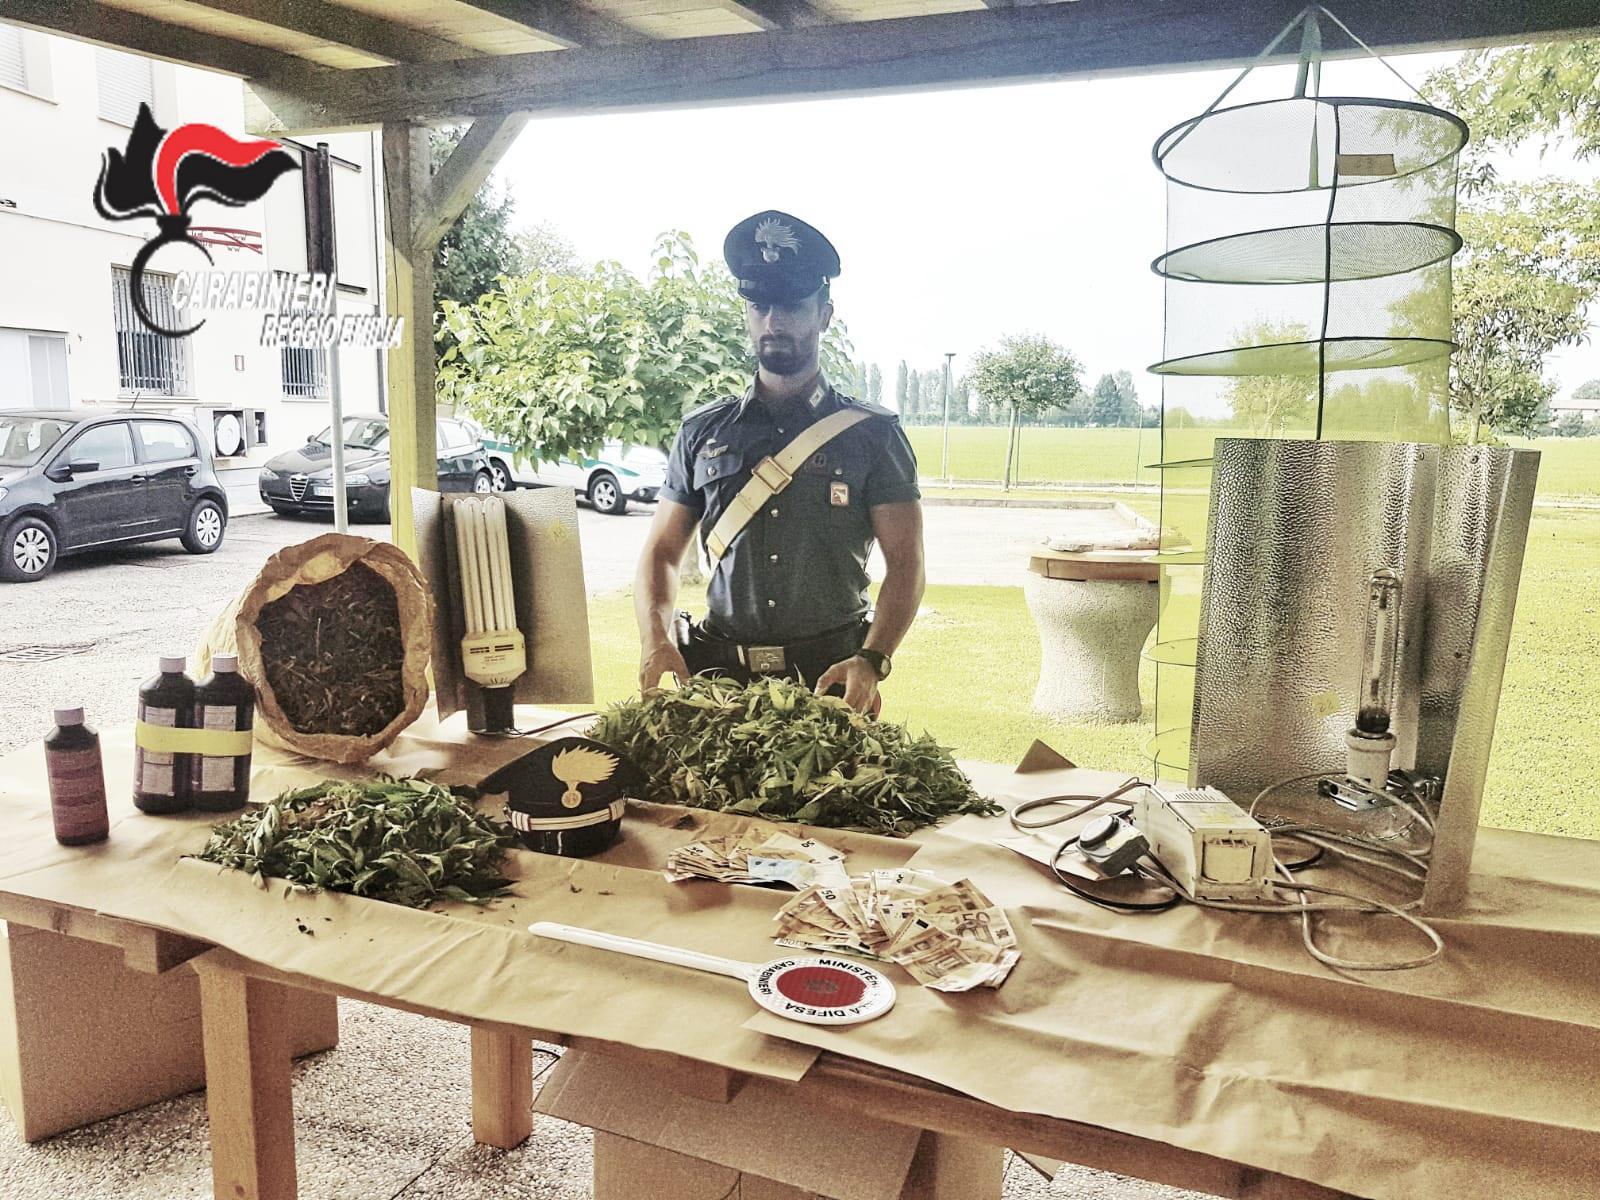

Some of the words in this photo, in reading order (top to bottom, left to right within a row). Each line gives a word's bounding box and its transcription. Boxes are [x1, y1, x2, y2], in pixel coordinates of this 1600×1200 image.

[821, 889, 837, 901] 50
[758, 960, 795, 995] CARABINIERI
[785, 1002, 846, 1018] DIFESA
